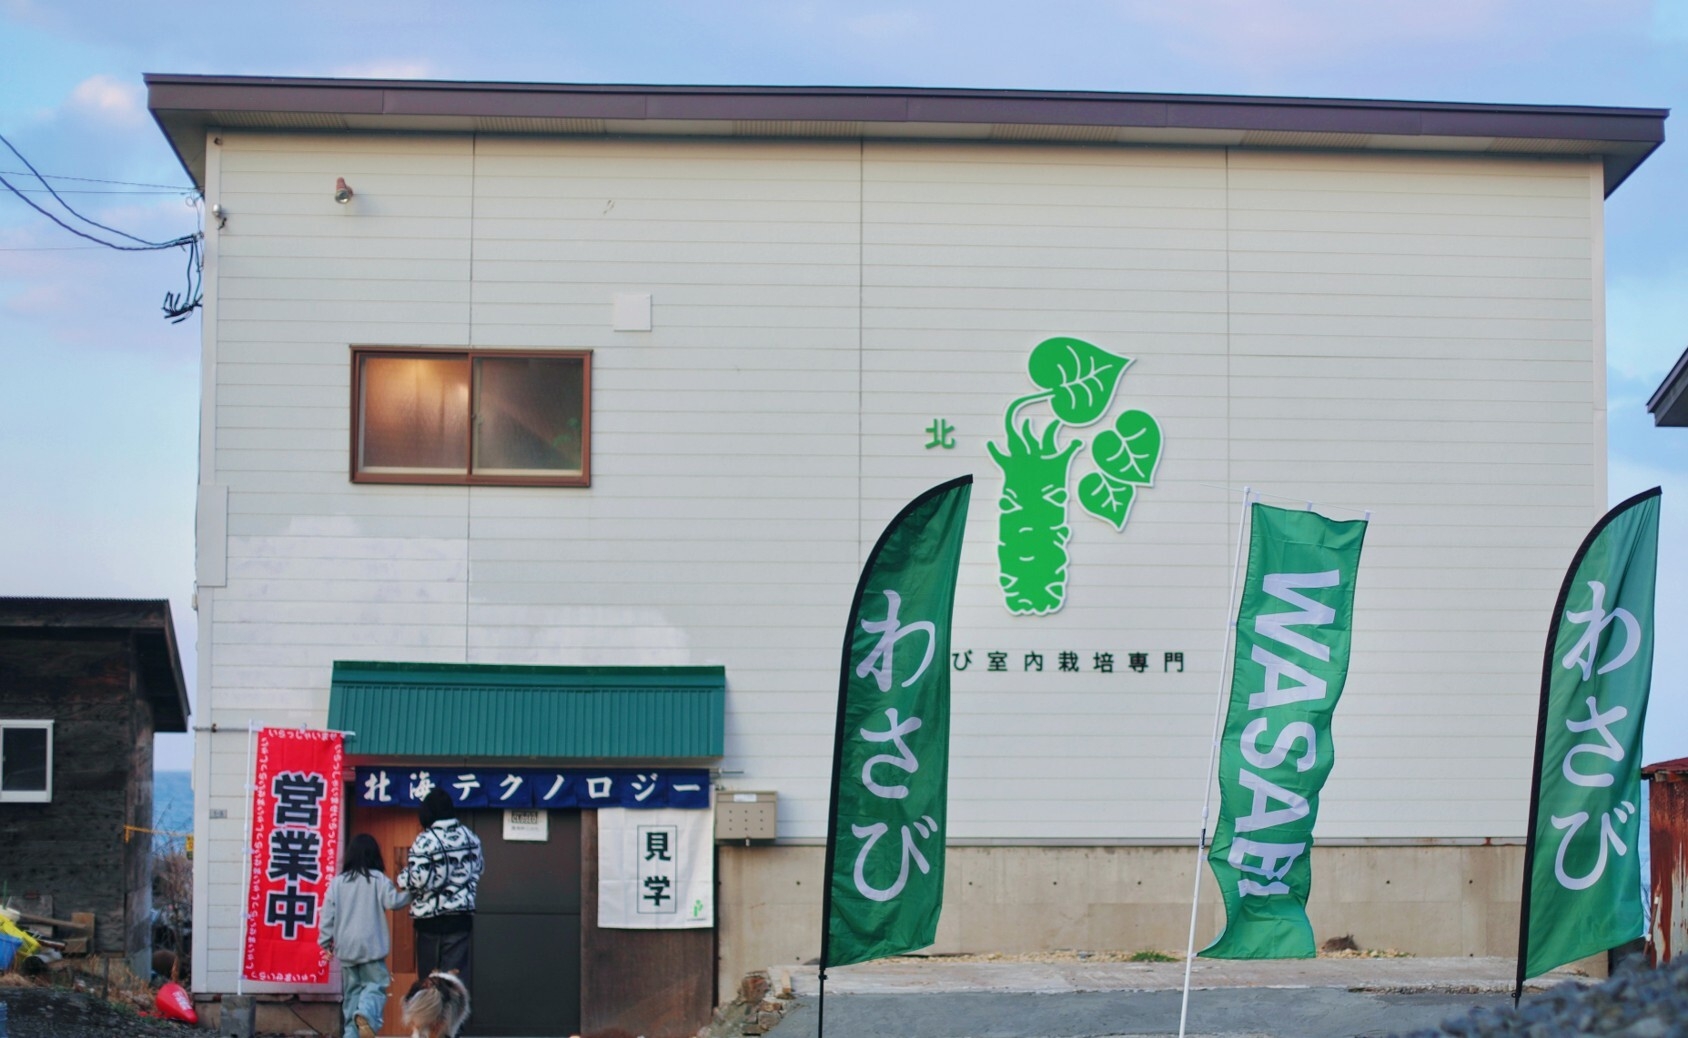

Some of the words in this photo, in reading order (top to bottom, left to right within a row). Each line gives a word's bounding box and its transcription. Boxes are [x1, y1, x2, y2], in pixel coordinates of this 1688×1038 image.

[926, 418, 956, 449] 北
[363, 770, 702, 806] 北海テクノロジー
[851, 589, 938, 902] わさび
[1228, 569, 1341, 898] WASABI
[1551, 580, 1641, 890] わさび
[263, 770, 328, 940] 営業中
[643, 831, 672, 907] 見学
